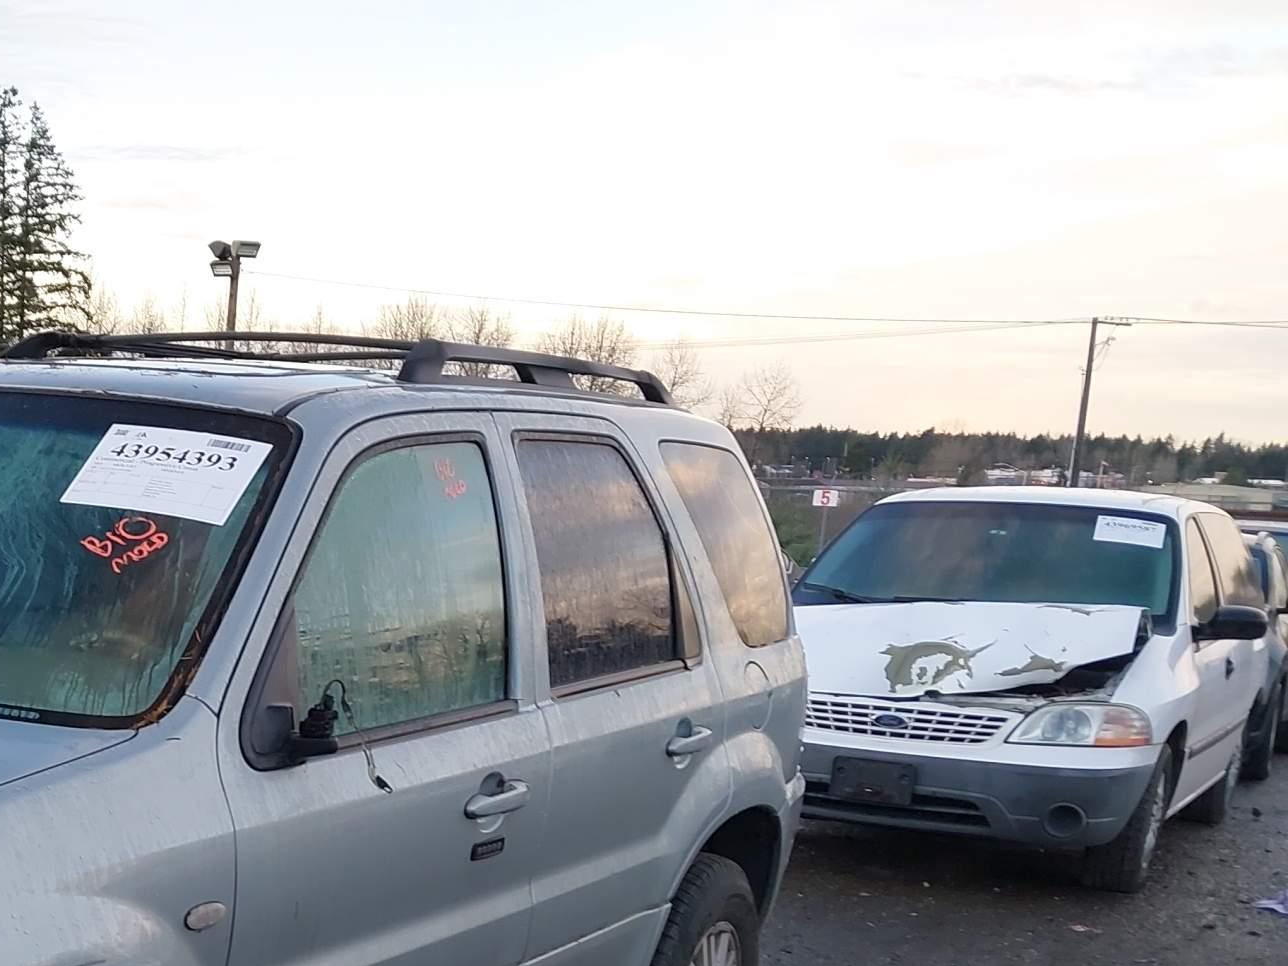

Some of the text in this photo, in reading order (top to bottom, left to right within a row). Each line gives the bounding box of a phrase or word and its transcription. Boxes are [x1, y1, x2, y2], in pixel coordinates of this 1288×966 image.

[110, 442, 238, 471] 43954393
[821, 491, 830, 505] 5
[79, 516, 156, 558] BIO
